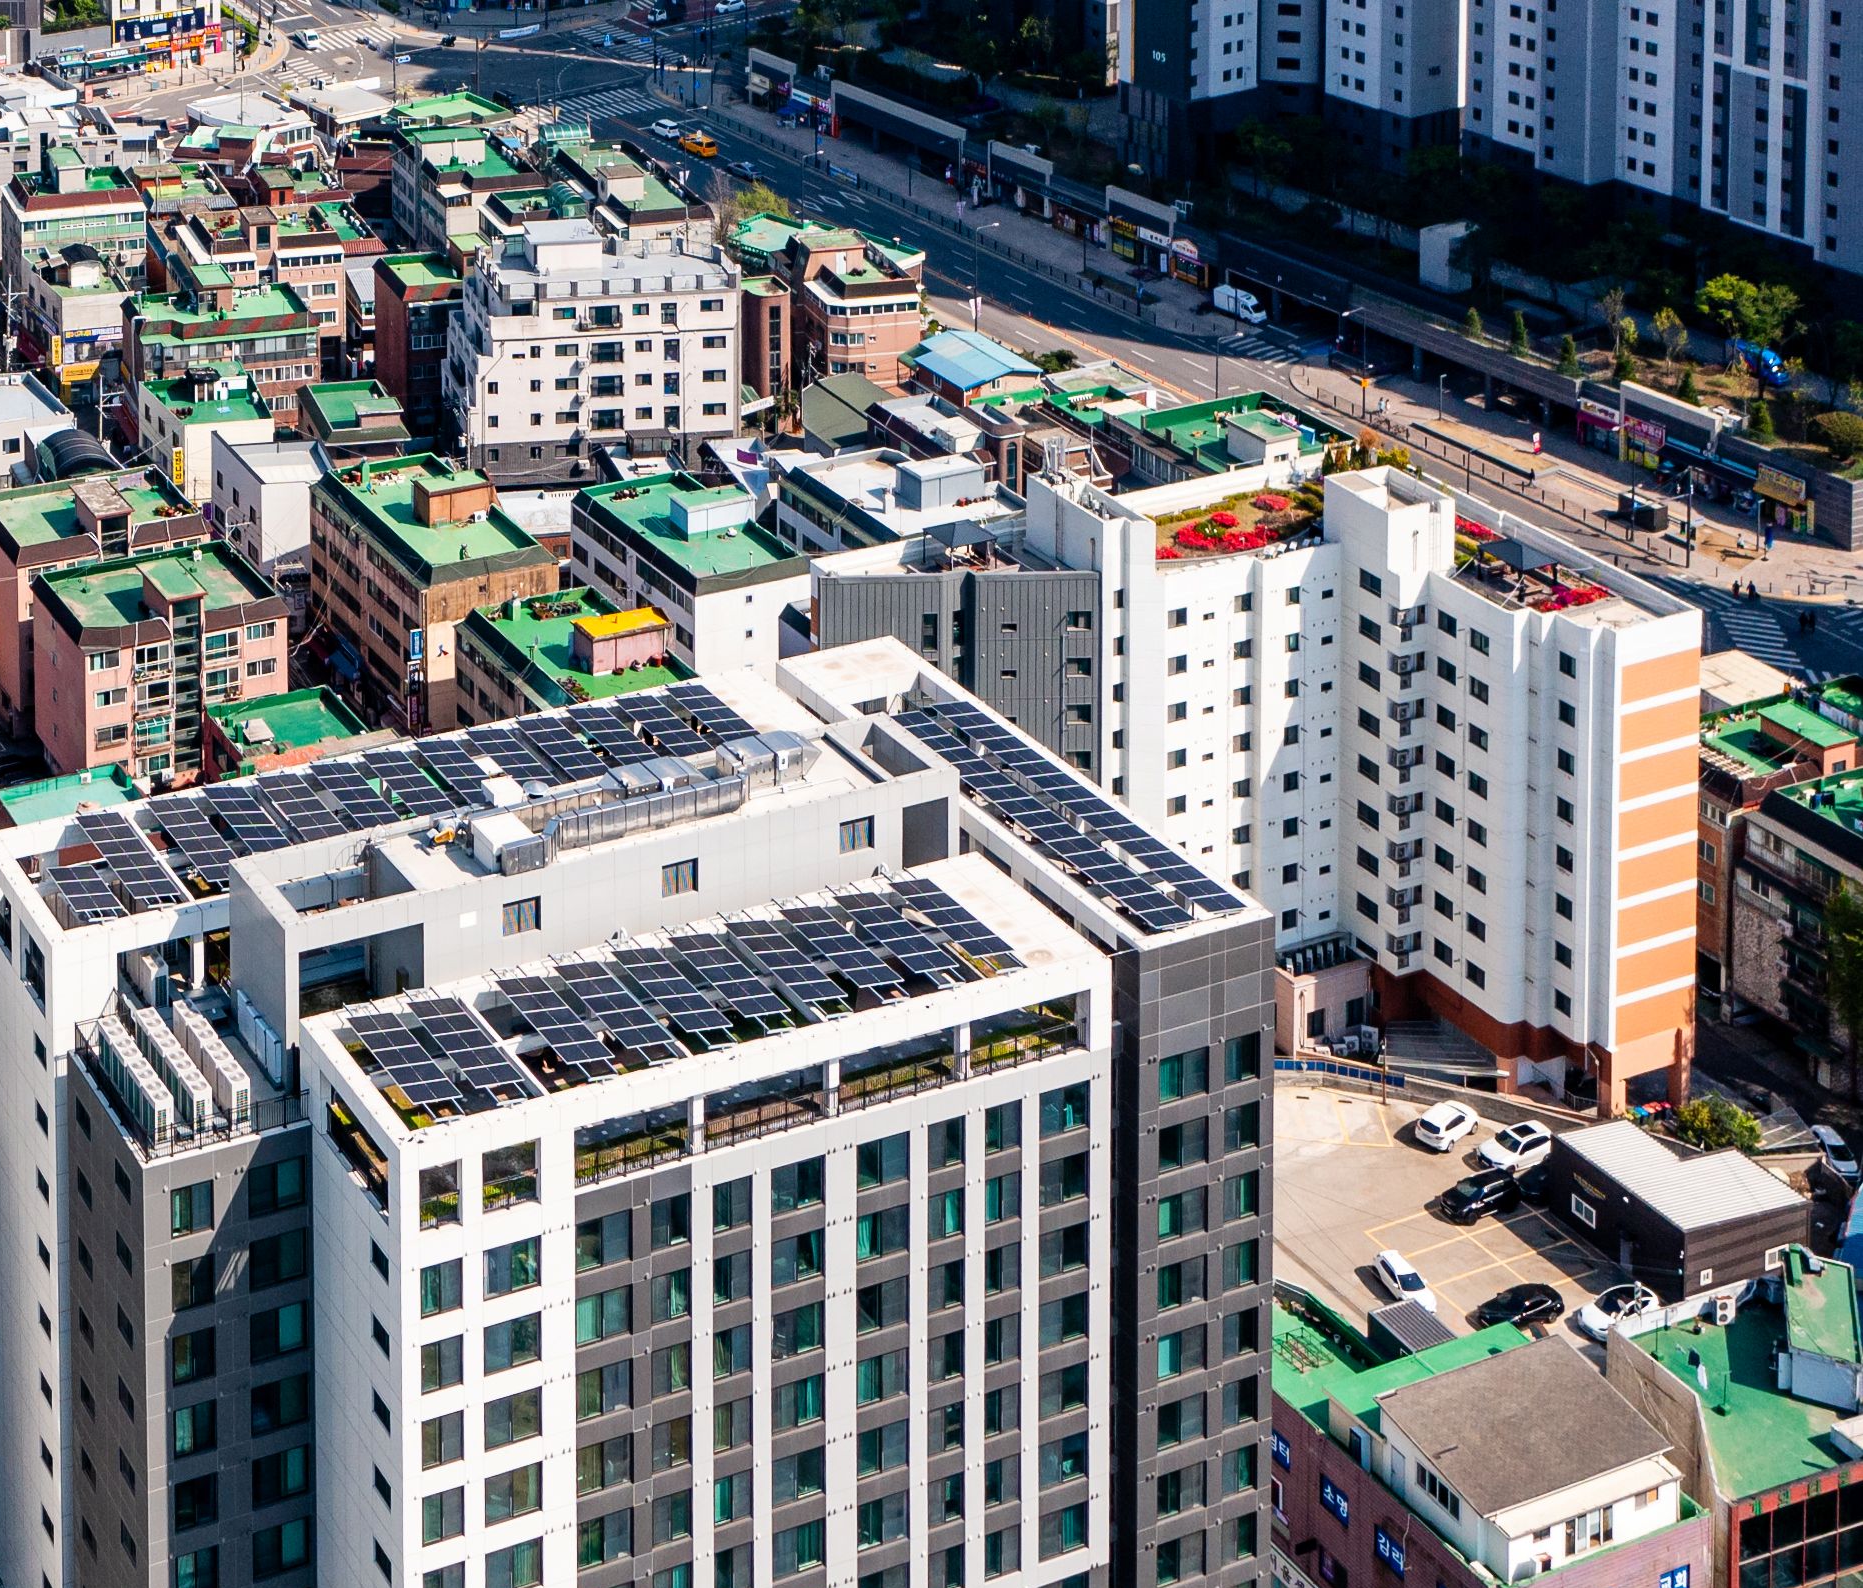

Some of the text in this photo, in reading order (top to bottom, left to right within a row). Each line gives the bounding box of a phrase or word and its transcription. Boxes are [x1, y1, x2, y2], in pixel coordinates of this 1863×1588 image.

[1152, 50, 1166, 63] 105
[1323, 1484, 1349, 1518] 소명
[1377, 1532, 1405, 1571] 감리
